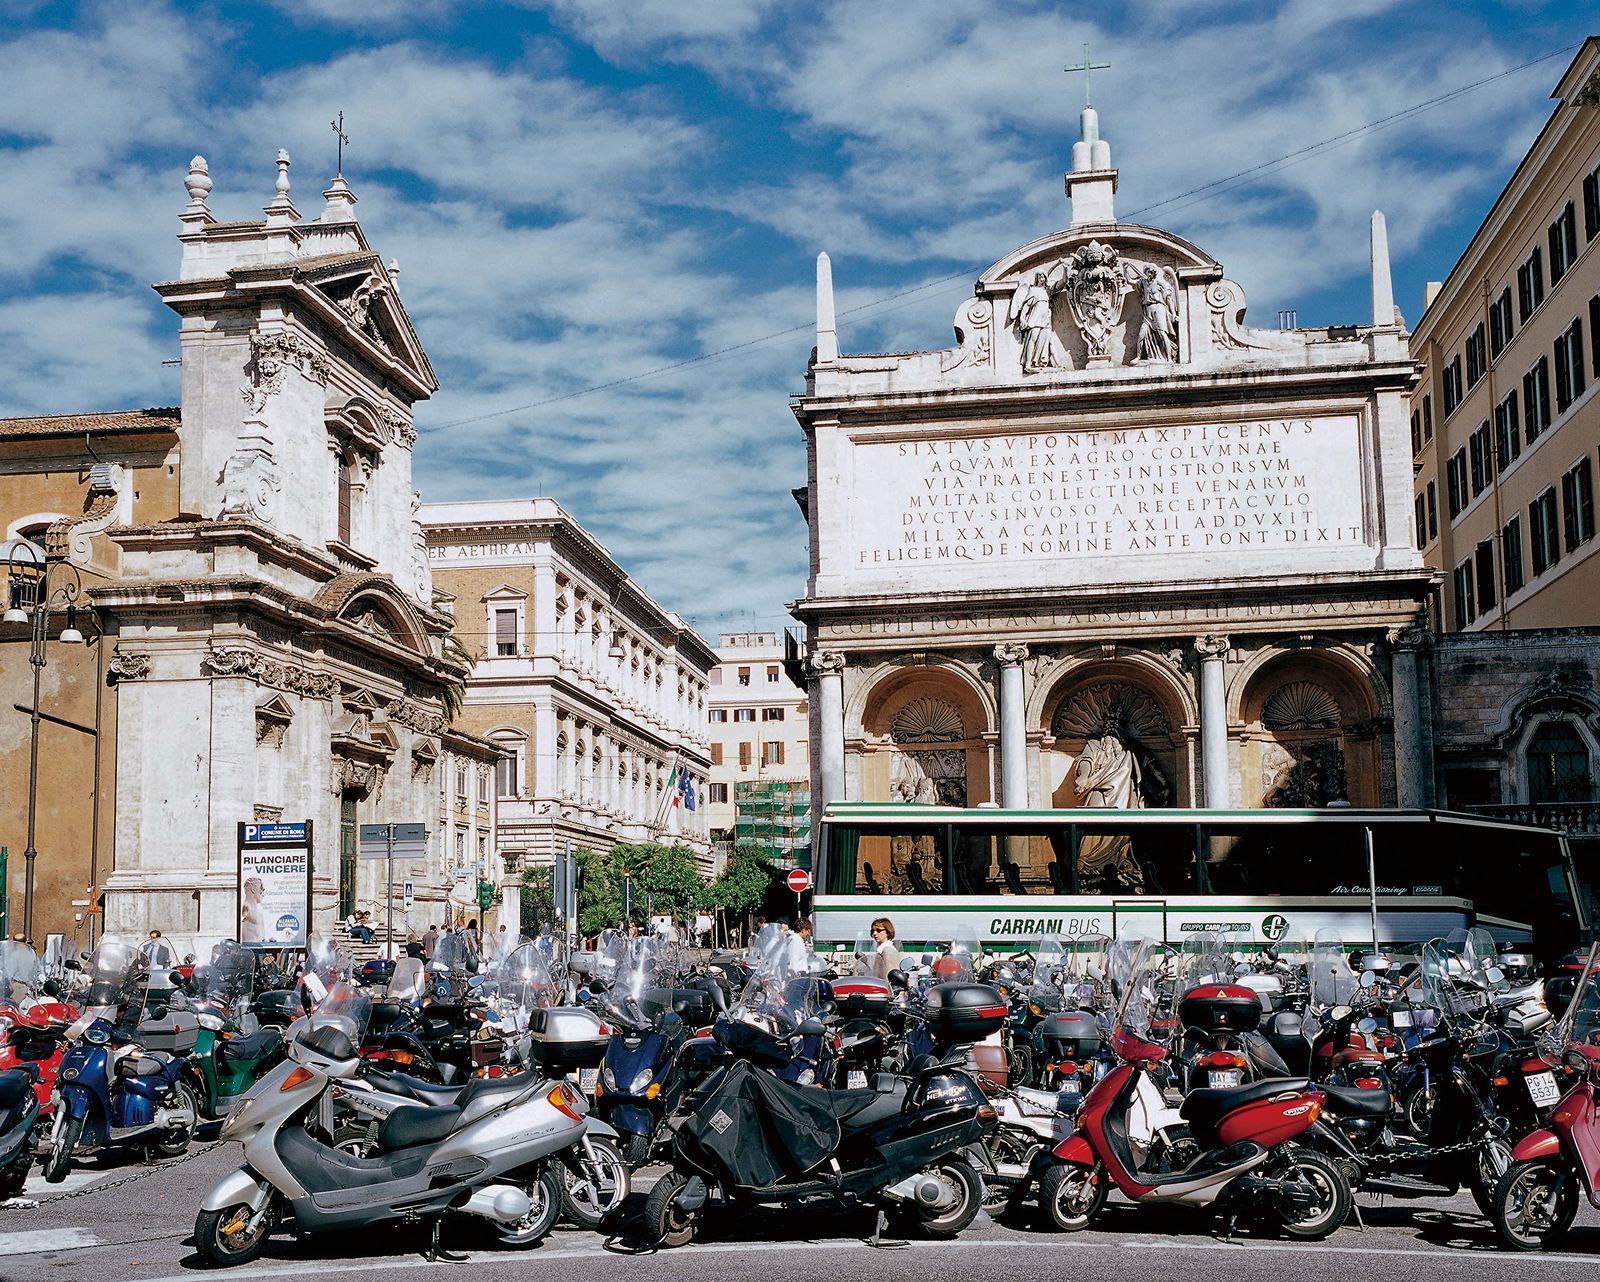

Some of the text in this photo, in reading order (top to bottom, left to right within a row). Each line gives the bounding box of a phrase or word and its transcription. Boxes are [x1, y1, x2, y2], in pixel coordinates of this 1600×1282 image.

[899, 420, 1313, 457] SIXTVS V PONT MAX PICENVS
[932, 441, 1282, 475] AQVAM EX AGRO COLVMNAE
[924, 458, 1291, 491] VIA PRAENEST SINISTRORSVM
[910, 475, 1307, 509] MVLTAR COLLECTIONE VENARVM
[903, 492, 1310, 527] DVCTV SINVOSO A RECEPTACVLO
[904, 511, 1313, 544] MIL XX A CAPITE XXII ADDVXIT
[428, 542, 537, 558] ER AETHRAM
[860, 526, 1360, 563] FELICEMQ DE NOMINE ANTE PONT DIXIT
[831, 615, 917, 635] COEPIT
[930, 612, 996, 631] PONT
[1006, 610, 1039, 627] AN
[1067, 604, 1190, 625] ABSOLVIT
[245, 825, 257, 840] P
[244, 855, 306, 864] RILANCIARE
[255, 864, 306, 873] VINCERE
[1331, 885, 1350, 894] Air
[1351, 885, 1407, 895] Condtioning
[990, 918, 1100, 935] CARRANI BUS
[1527, 1073, 1554, 1088] PG 14
[1531, 1085, 1555, 1100] 5537
